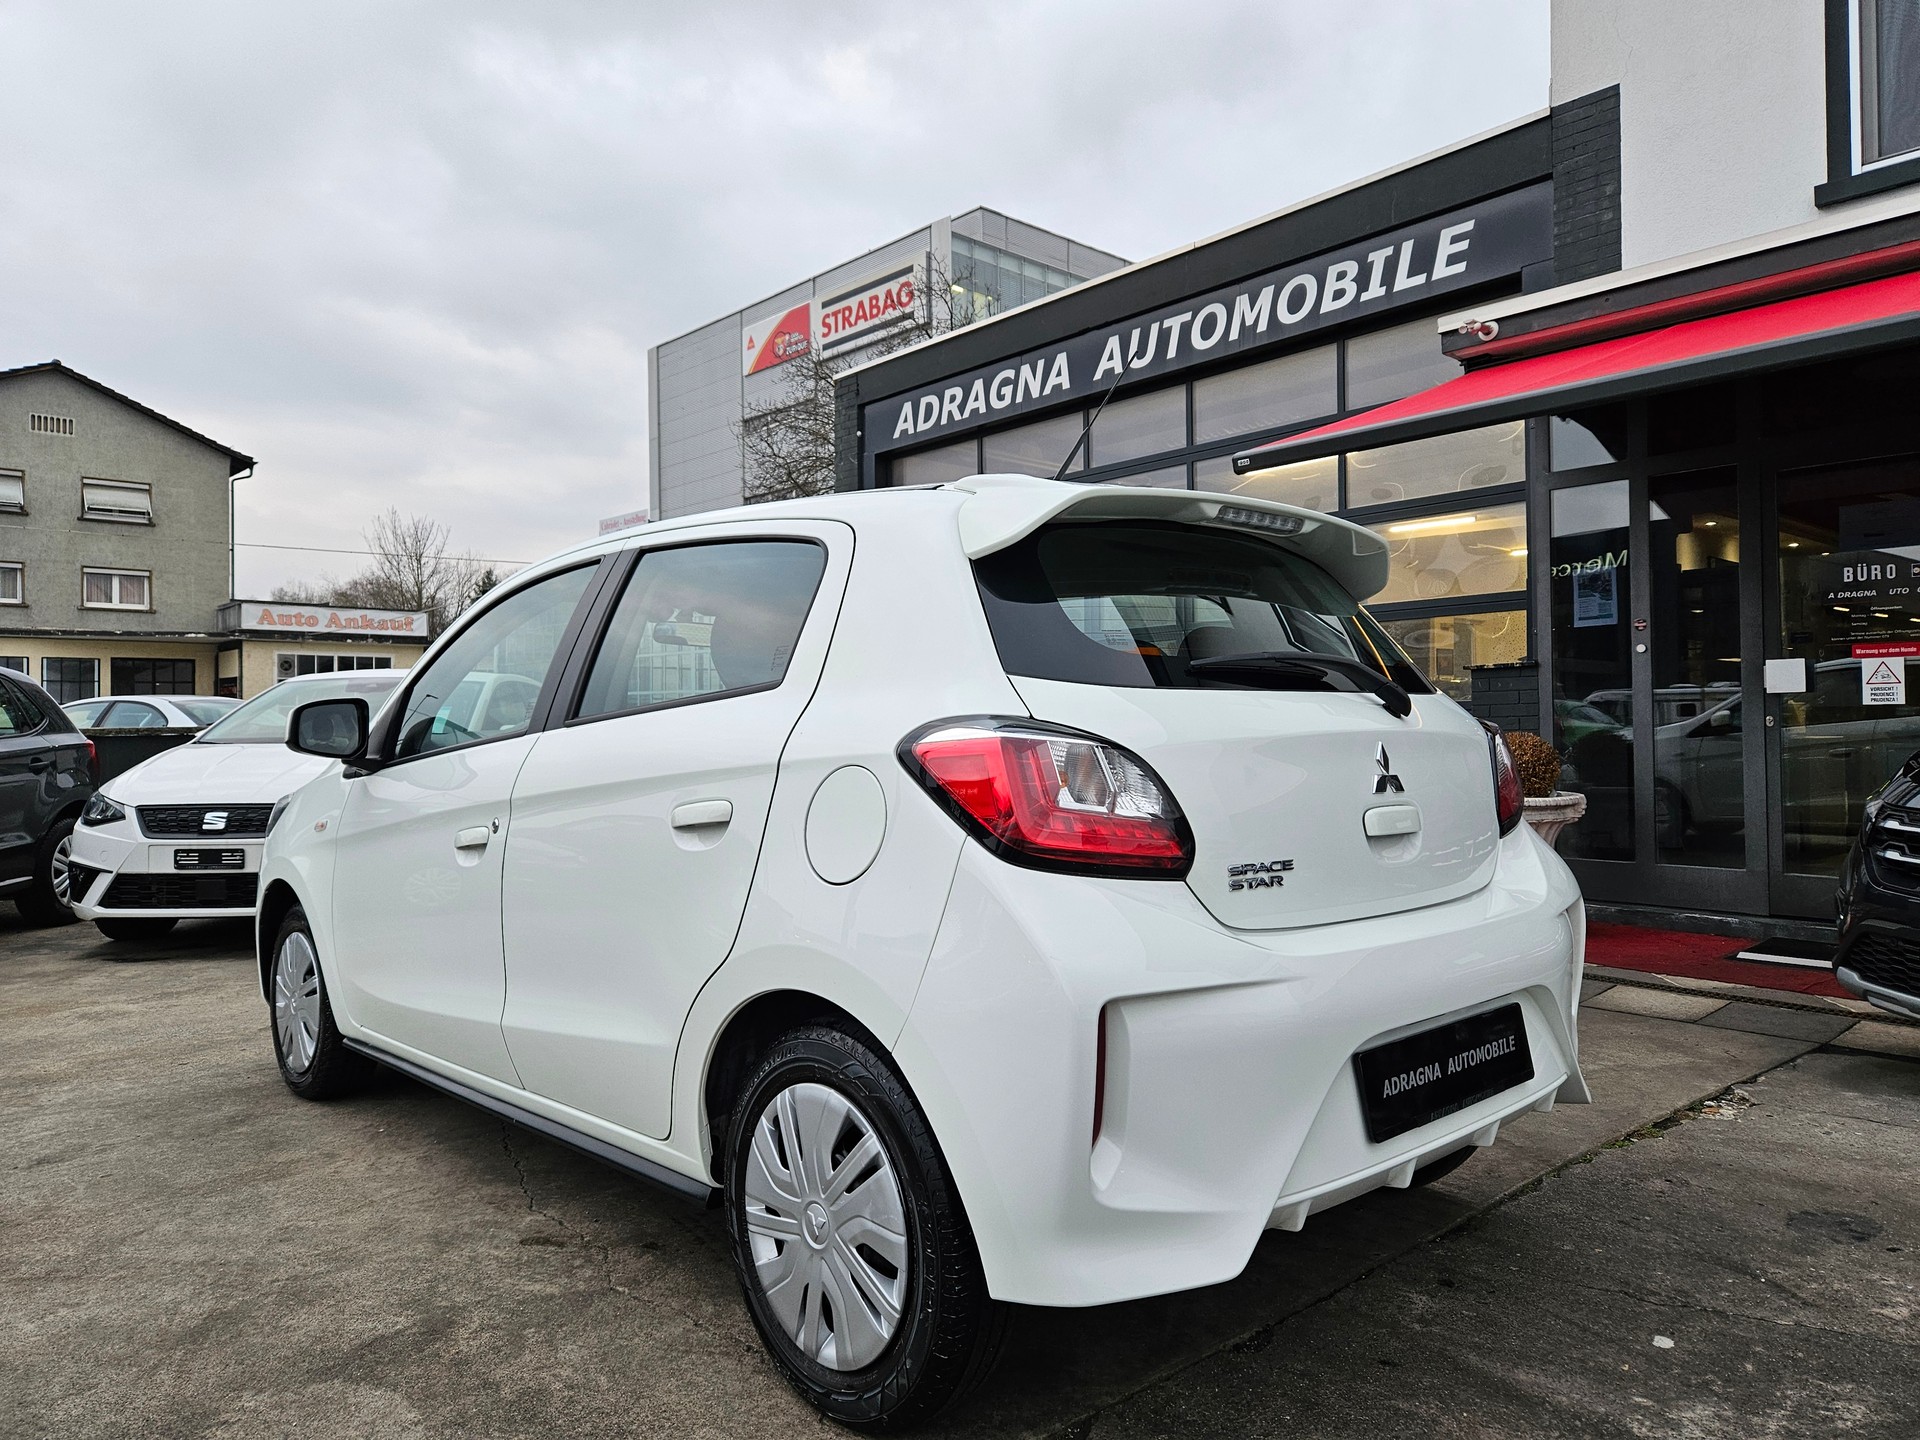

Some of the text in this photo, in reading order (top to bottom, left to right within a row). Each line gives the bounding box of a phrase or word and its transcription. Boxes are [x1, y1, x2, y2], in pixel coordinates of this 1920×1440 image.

[821, 281, 914, 338] STRABAG
[892, 218, 1475, 439] ADRAGNA AUTOMOBILE
[1843, 563, 1896, 583] BÜRO
[256, 608, 414, 632] Auto Ankauf
[1227, 859, 1295, 877] SPACE
[1228, 875, 1285, 892] STAR
[1383, 1035, 1516, 1099] ADRAGNA AUTOMOBILE
